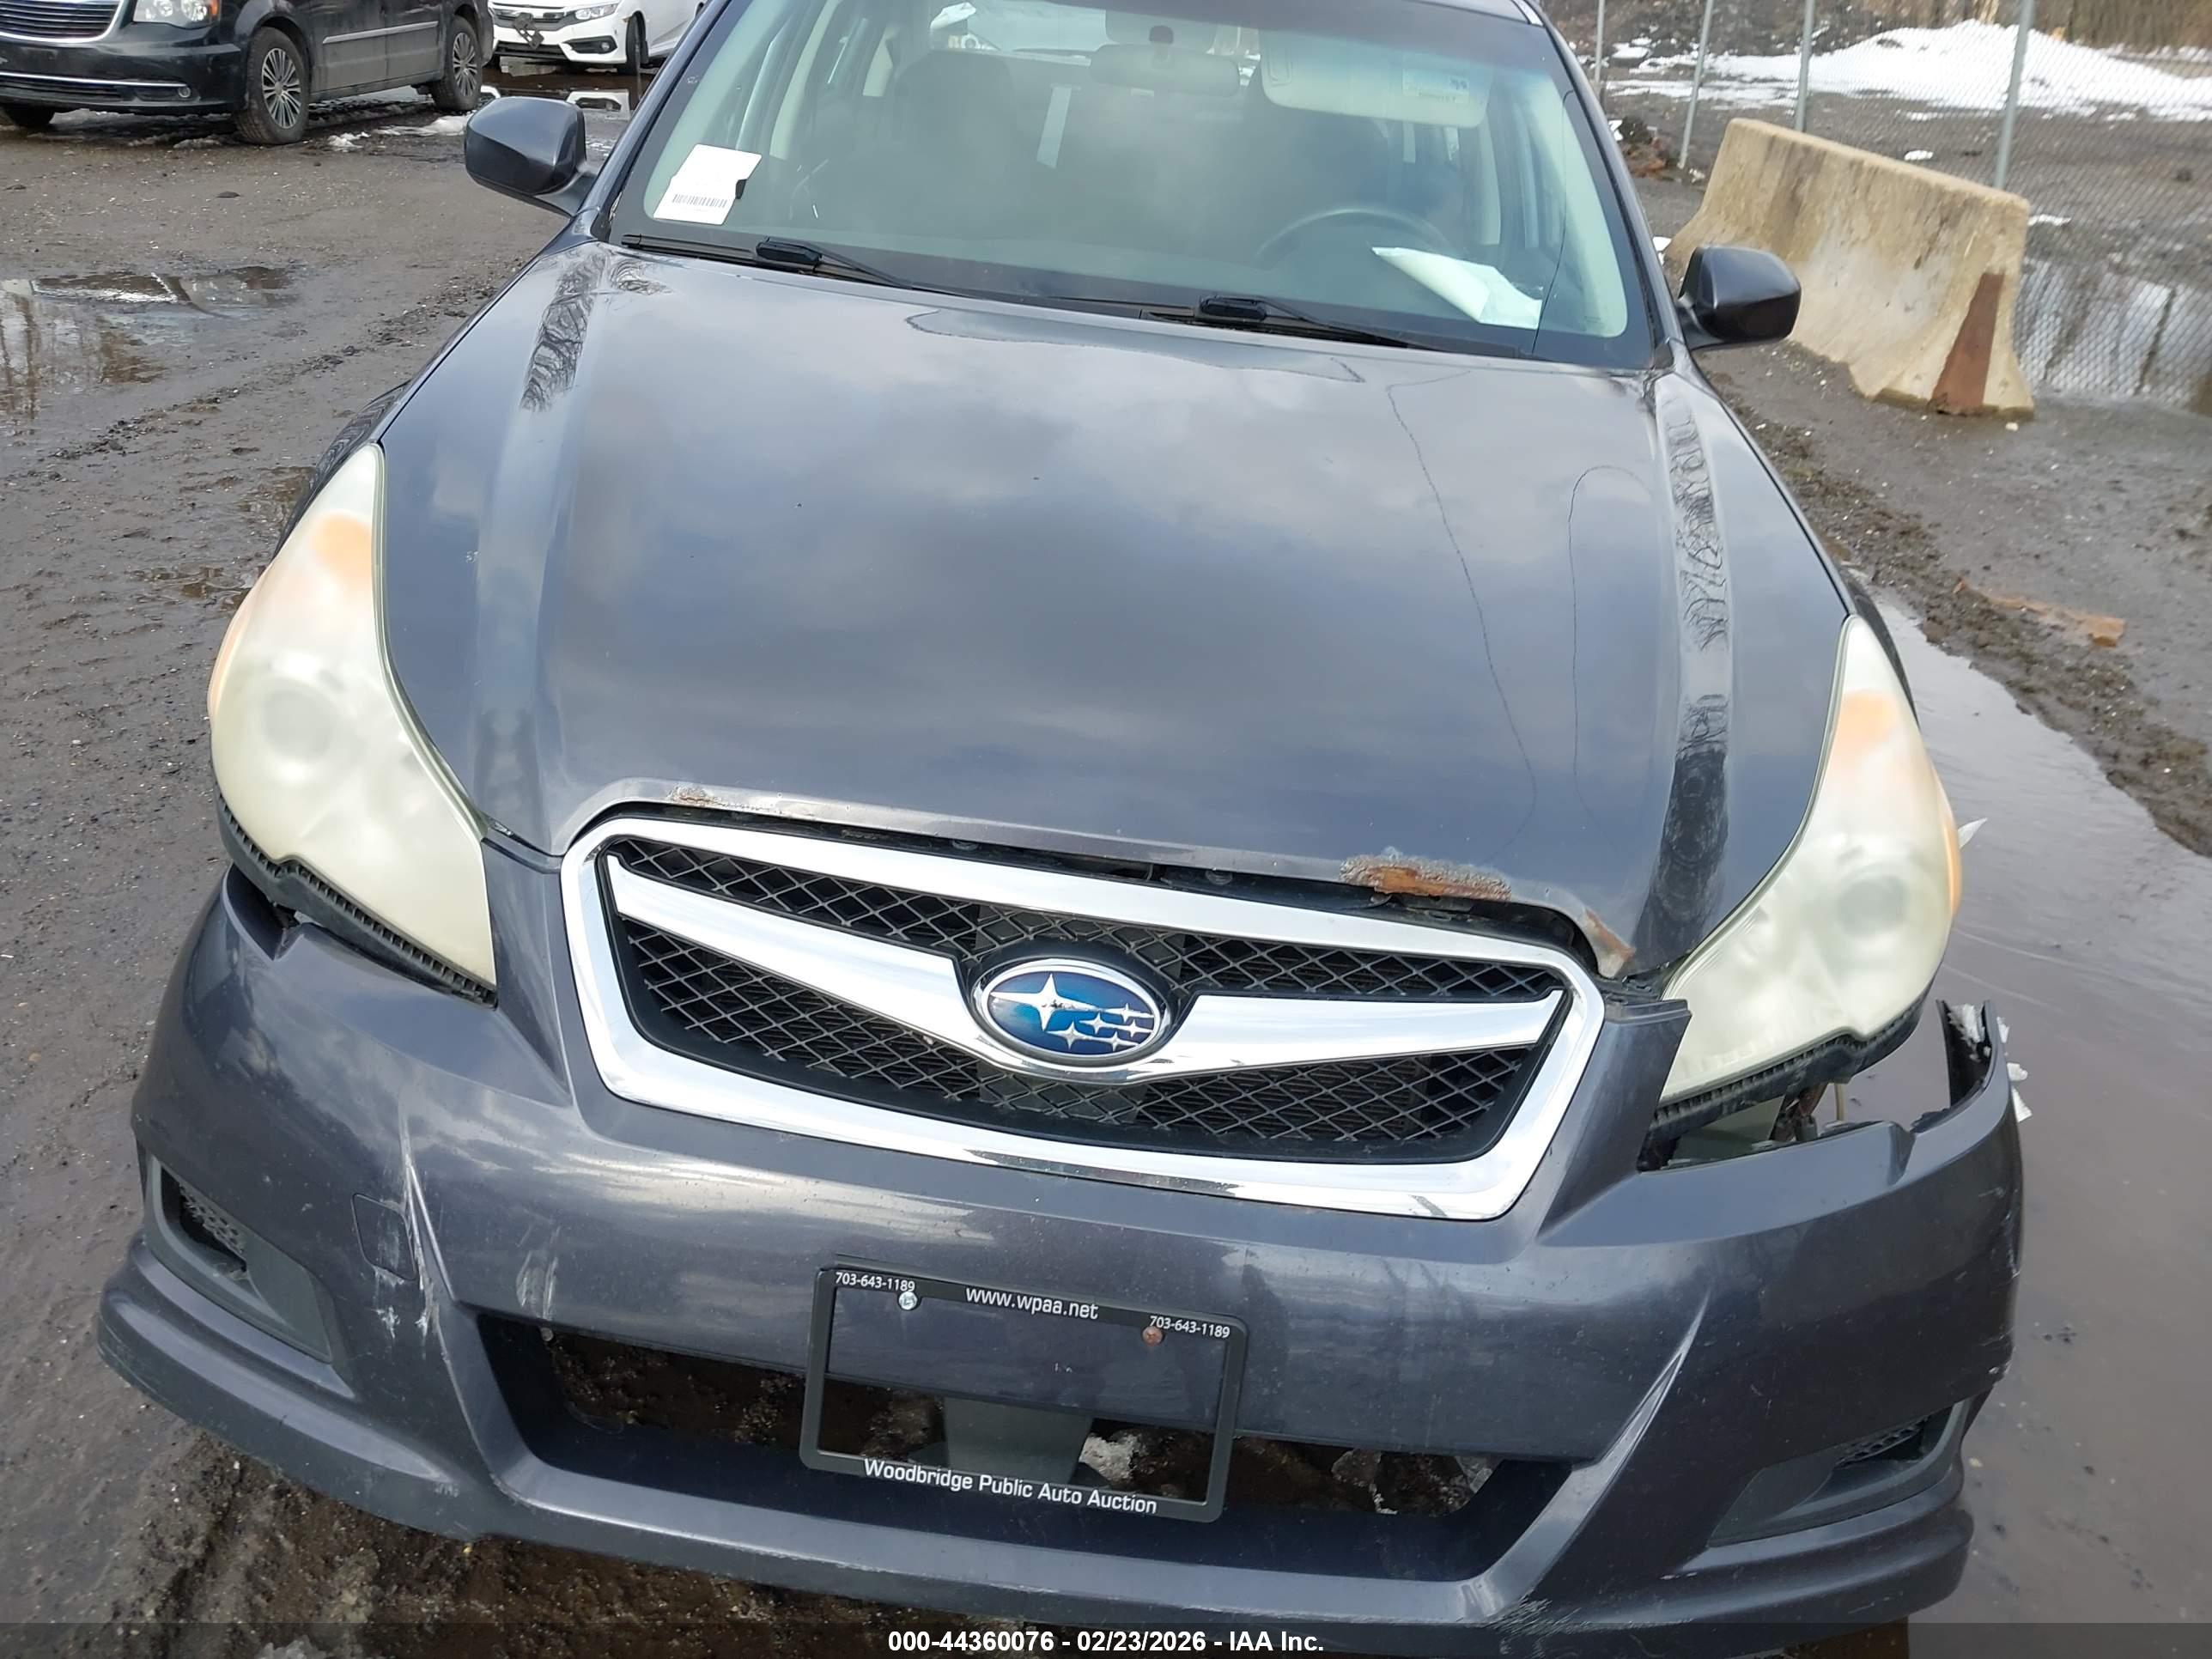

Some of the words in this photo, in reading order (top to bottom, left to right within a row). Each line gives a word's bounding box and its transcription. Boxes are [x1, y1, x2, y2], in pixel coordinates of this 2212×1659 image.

[836, 1272, 915, 1291] 703-643-1189
[966, 1287, 1099, 1320] www.wpaa.net
[1150, 1316, 1231, 1338] 703-643-1189
[864, 1458, 974, 1492] Woodbridge
[978, 1474, 1033, 1498] Public
[1037, 1482, 1083, 1504] Auto
[1086, 1489, 1158, 1514] Auction
